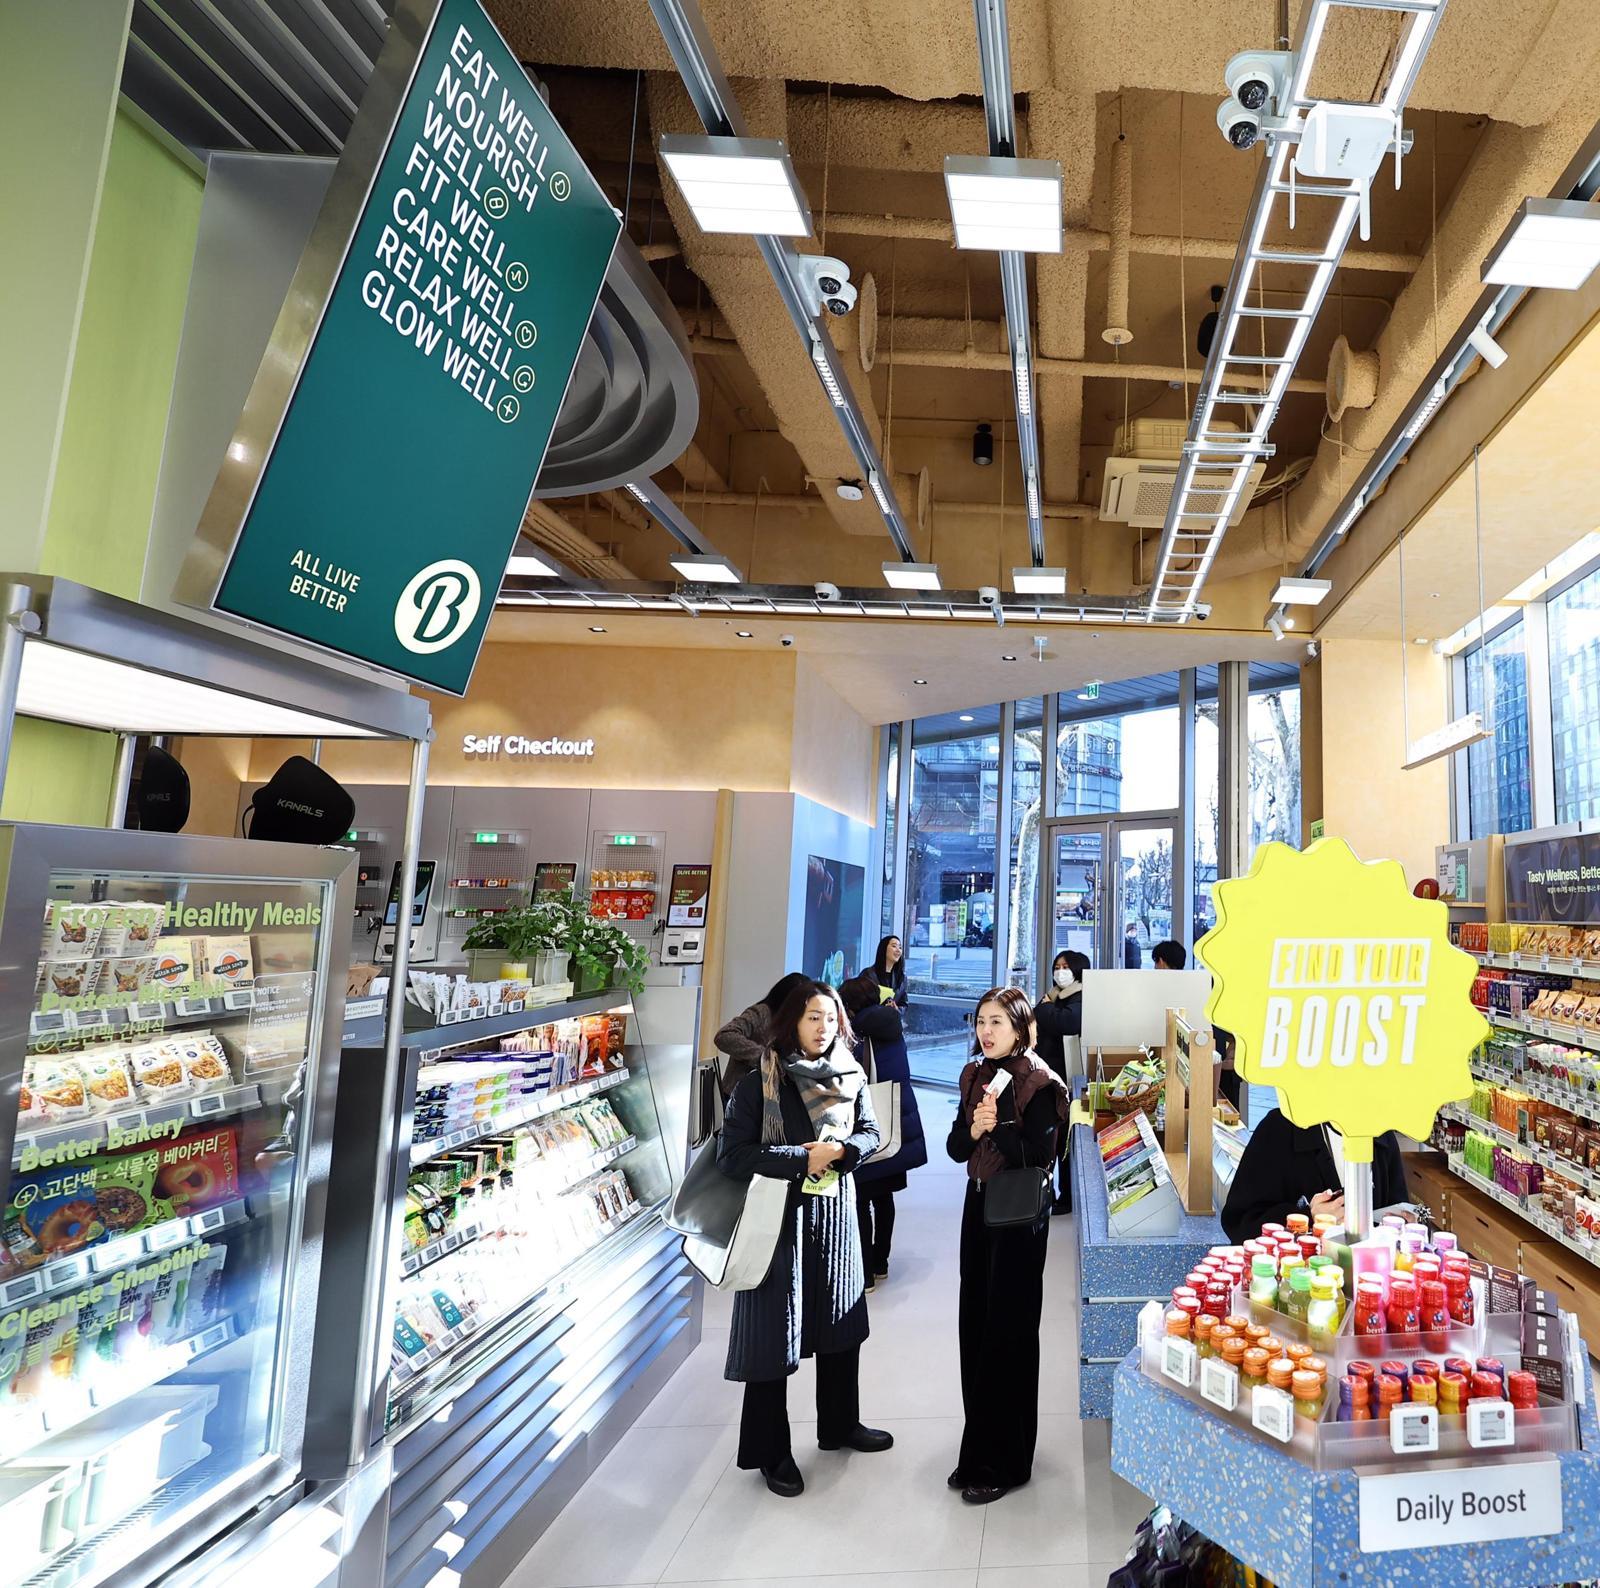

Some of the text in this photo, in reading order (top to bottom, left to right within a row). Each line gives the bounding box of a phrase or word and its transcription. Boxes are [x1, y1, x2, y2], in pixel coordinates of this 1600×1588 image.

[450, 24, 548, 181] EAT WELL
[423, 100, 485, 201] WELL
[435, 64, 539, 212] NOURISH
[405, 142, 505, 277] FIT WELL
[393, 187, 514, 336] CARE WELL
[375, 225, 511, 381] RELAX WELL
[361, 270, 494, 412] GLOW WELL
[289, 574, 347, 613] BETTER
[290, 549, 360, 593] ALL LIVE
[463, 735, 594, 756] Self Checkout
[277, 798, 325, 818] KANALS
[1527, 871, 1545, 885] Tasty
[1545, 869, 1580, 882] Wellness,
[51, 900, 322, 932] Frozen Healthy Meals
[257, 985, 281, 995] NOTICE
[1276, 943, 1425, 984] FIND YOUR
[1260, 994, 1427, 1068] BOOST
[19, 1117, 185, 1172] Better Bakery
[43, 1168, 98, 1199] 고단백
[113, 1153, 160, 1179] 식물성
[163, 1136, 219, 1165] 베이커리
[0, 1283, 104, 1339] Cleanse
[110, 1240, 210, 1296] Smoothie
[1396, 1487, 1527, 1525] Daily Boost
